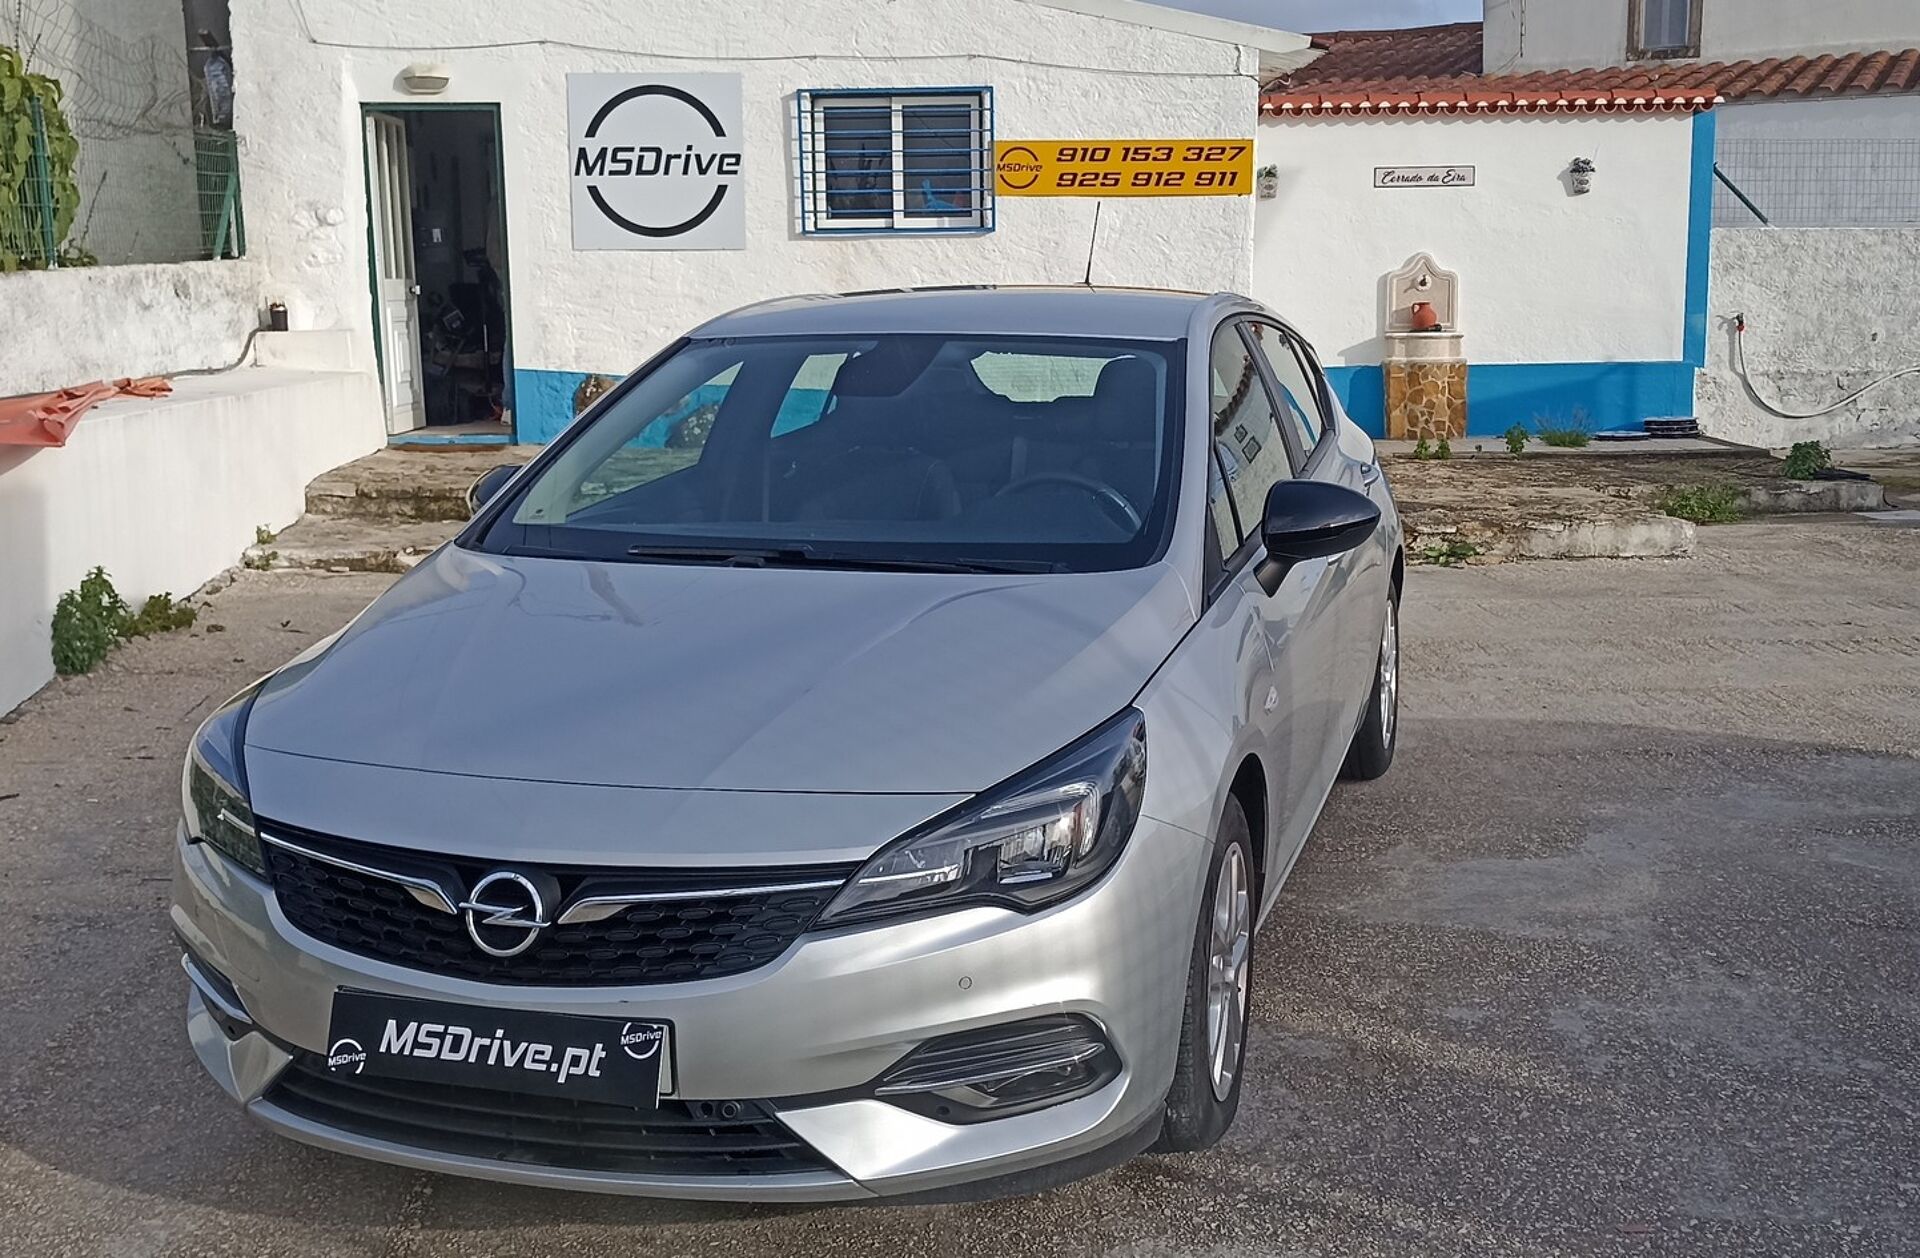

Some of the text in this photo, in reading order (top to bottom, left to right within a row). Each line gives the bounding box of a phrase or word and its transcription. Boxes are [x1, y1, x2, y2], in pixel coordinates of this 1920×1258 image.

[574, 145, 741, 176] MSDrive
[1056, 146, 1246, 162] 910 153 327
[996, 163, 1043, 172] MSDrive
[1056, 171, 1239, 187] 925 912 911
[1426, 173, 1440, 182] da
[1441, 169, 1466, 184] Eira
[620, 1030, 662, 1045] MSDrive
[379, 1019, 607, 1084] MSDrive.pt
[328, 1052, 367, 1067] MSDrive
